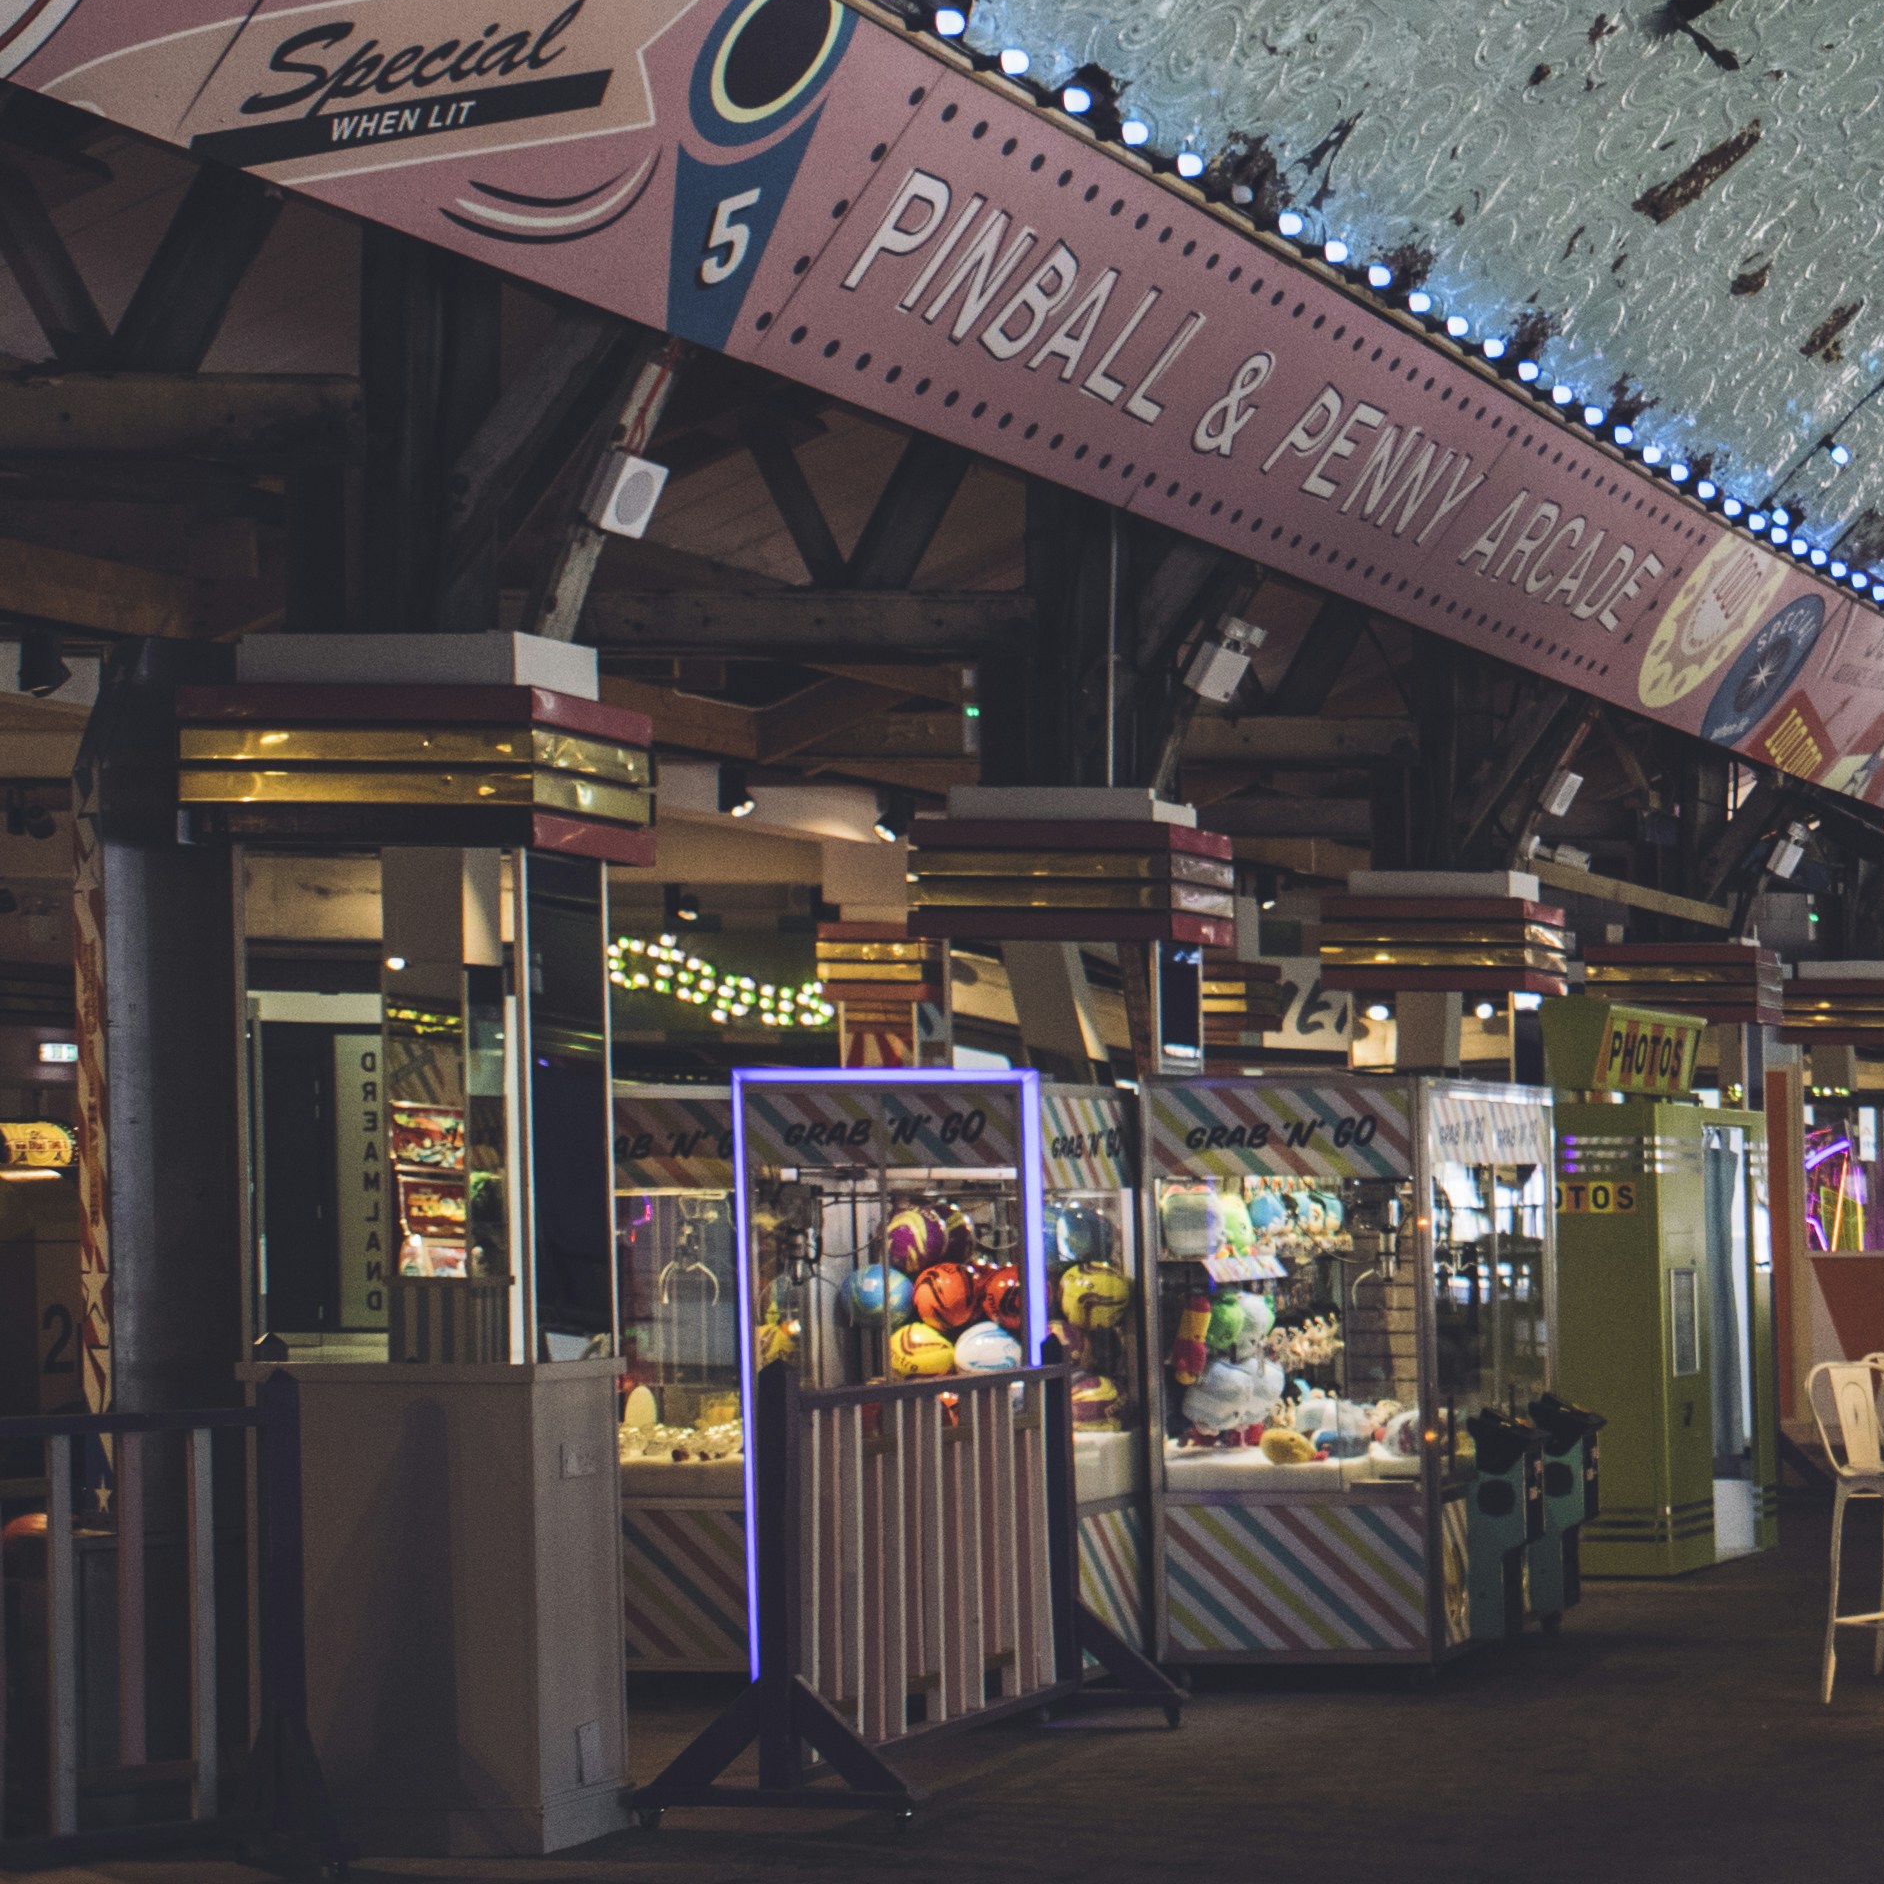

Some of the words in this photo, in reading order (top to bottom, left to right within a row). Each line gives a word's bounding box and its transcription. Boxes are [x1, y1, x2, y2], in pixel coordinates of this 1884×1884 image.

[330, 105, 419, 142] WHEN
[427, 100, 477, 129] LIT
[700, 188, 761, 285] 5
[841, 168, 1206, 427] PINBALL
[1192, 351, 1276, 456] &
[1260, 383, 1489, 548] PENNY
[1458, 488, 1665, 633] ARCADE
[1607, 1030, 1684, 1078] PHOTOS
[784, 1118, 870, 1147] GRAB
[941, 1110, 987, 1146] GO
[1051, 1134, 1083, 1159] GRAB
[1185, 1124, 1267, 1150] GRAB
[1333, 1115, 1377, 1148] GO
